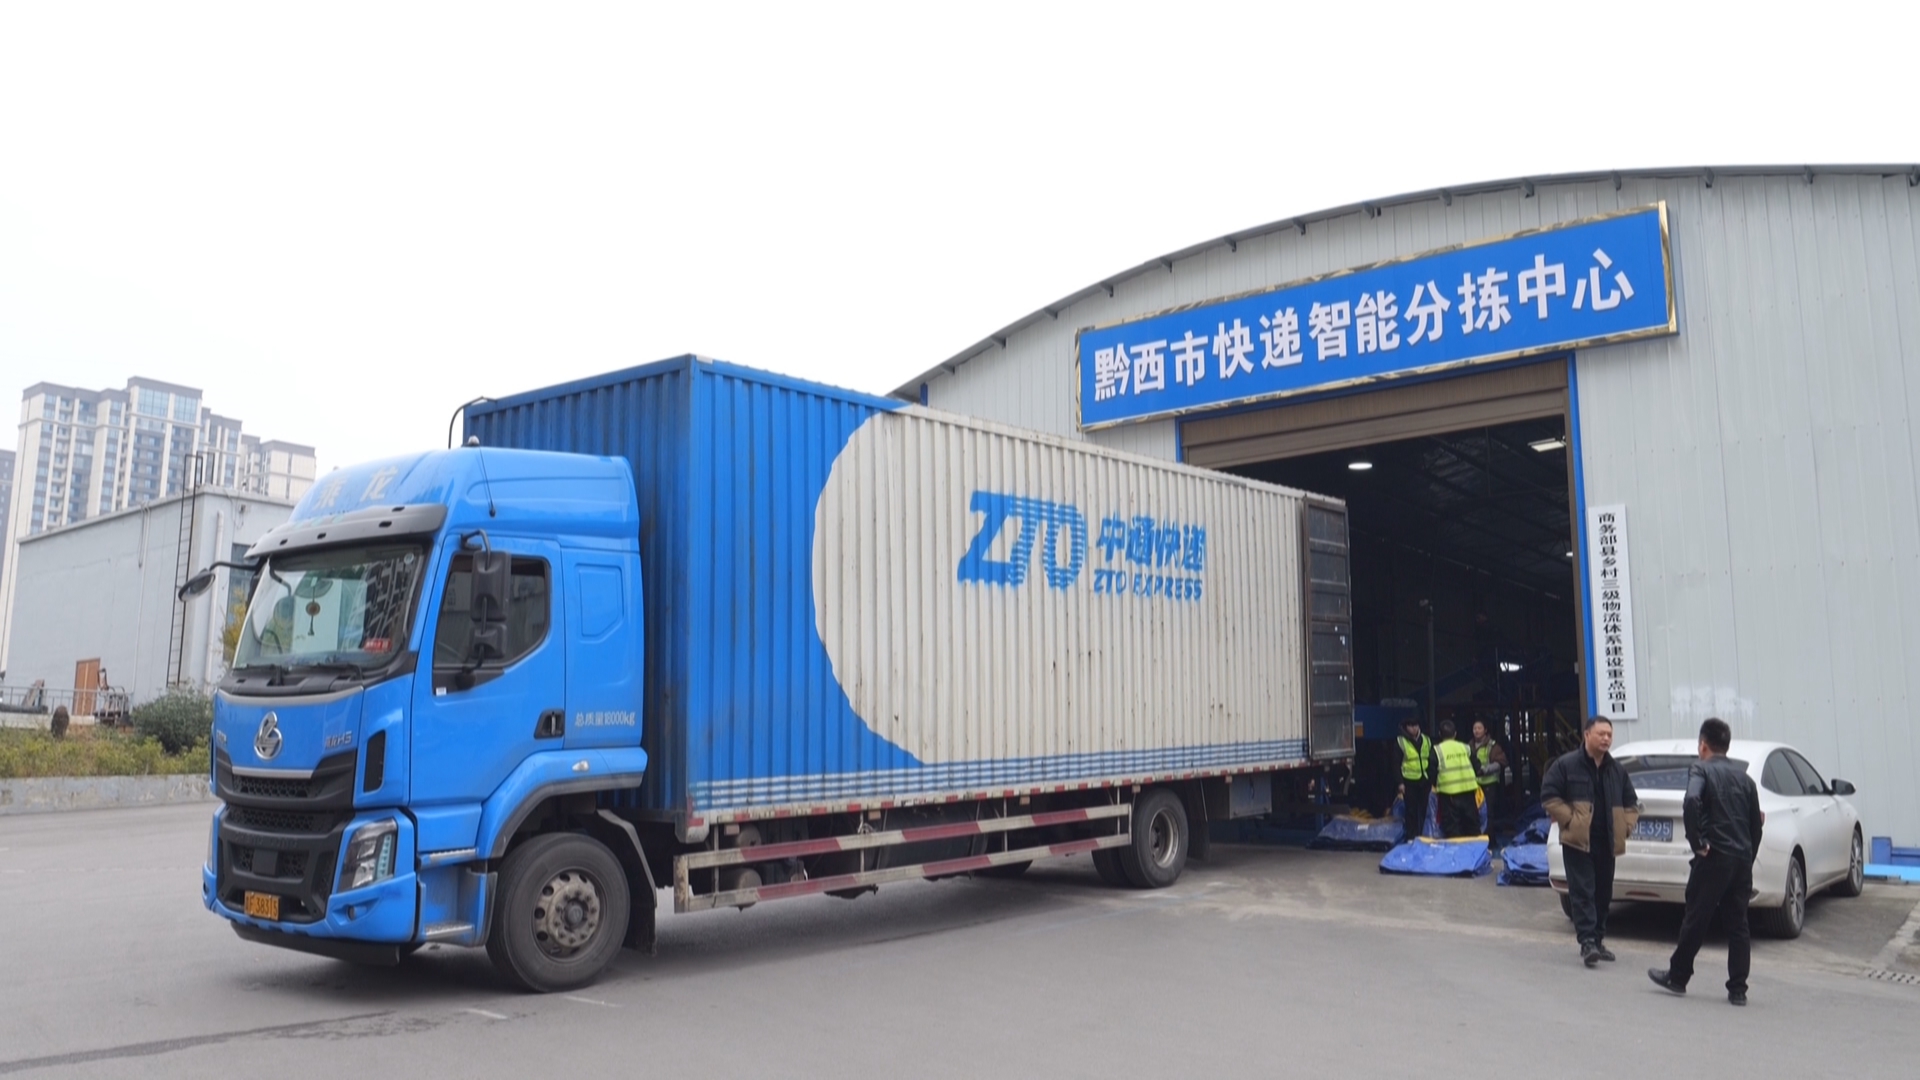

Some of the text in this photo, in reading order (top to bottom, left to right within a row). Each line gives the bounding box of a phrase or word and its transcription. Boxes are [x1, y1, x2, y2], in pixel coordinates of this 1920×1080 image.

[1094, 249, 1634, 400] 黔西市快递智能分拣中心
[957, 490, 1086, 592] ZTO
[1093, 569, 1203, 600] ZTO EXPRESS
[1096, 511, 1206, 573] 中通快递
[1599, 512, 1626, 713] 商务部县乡村三级物流体系建设重点项目
